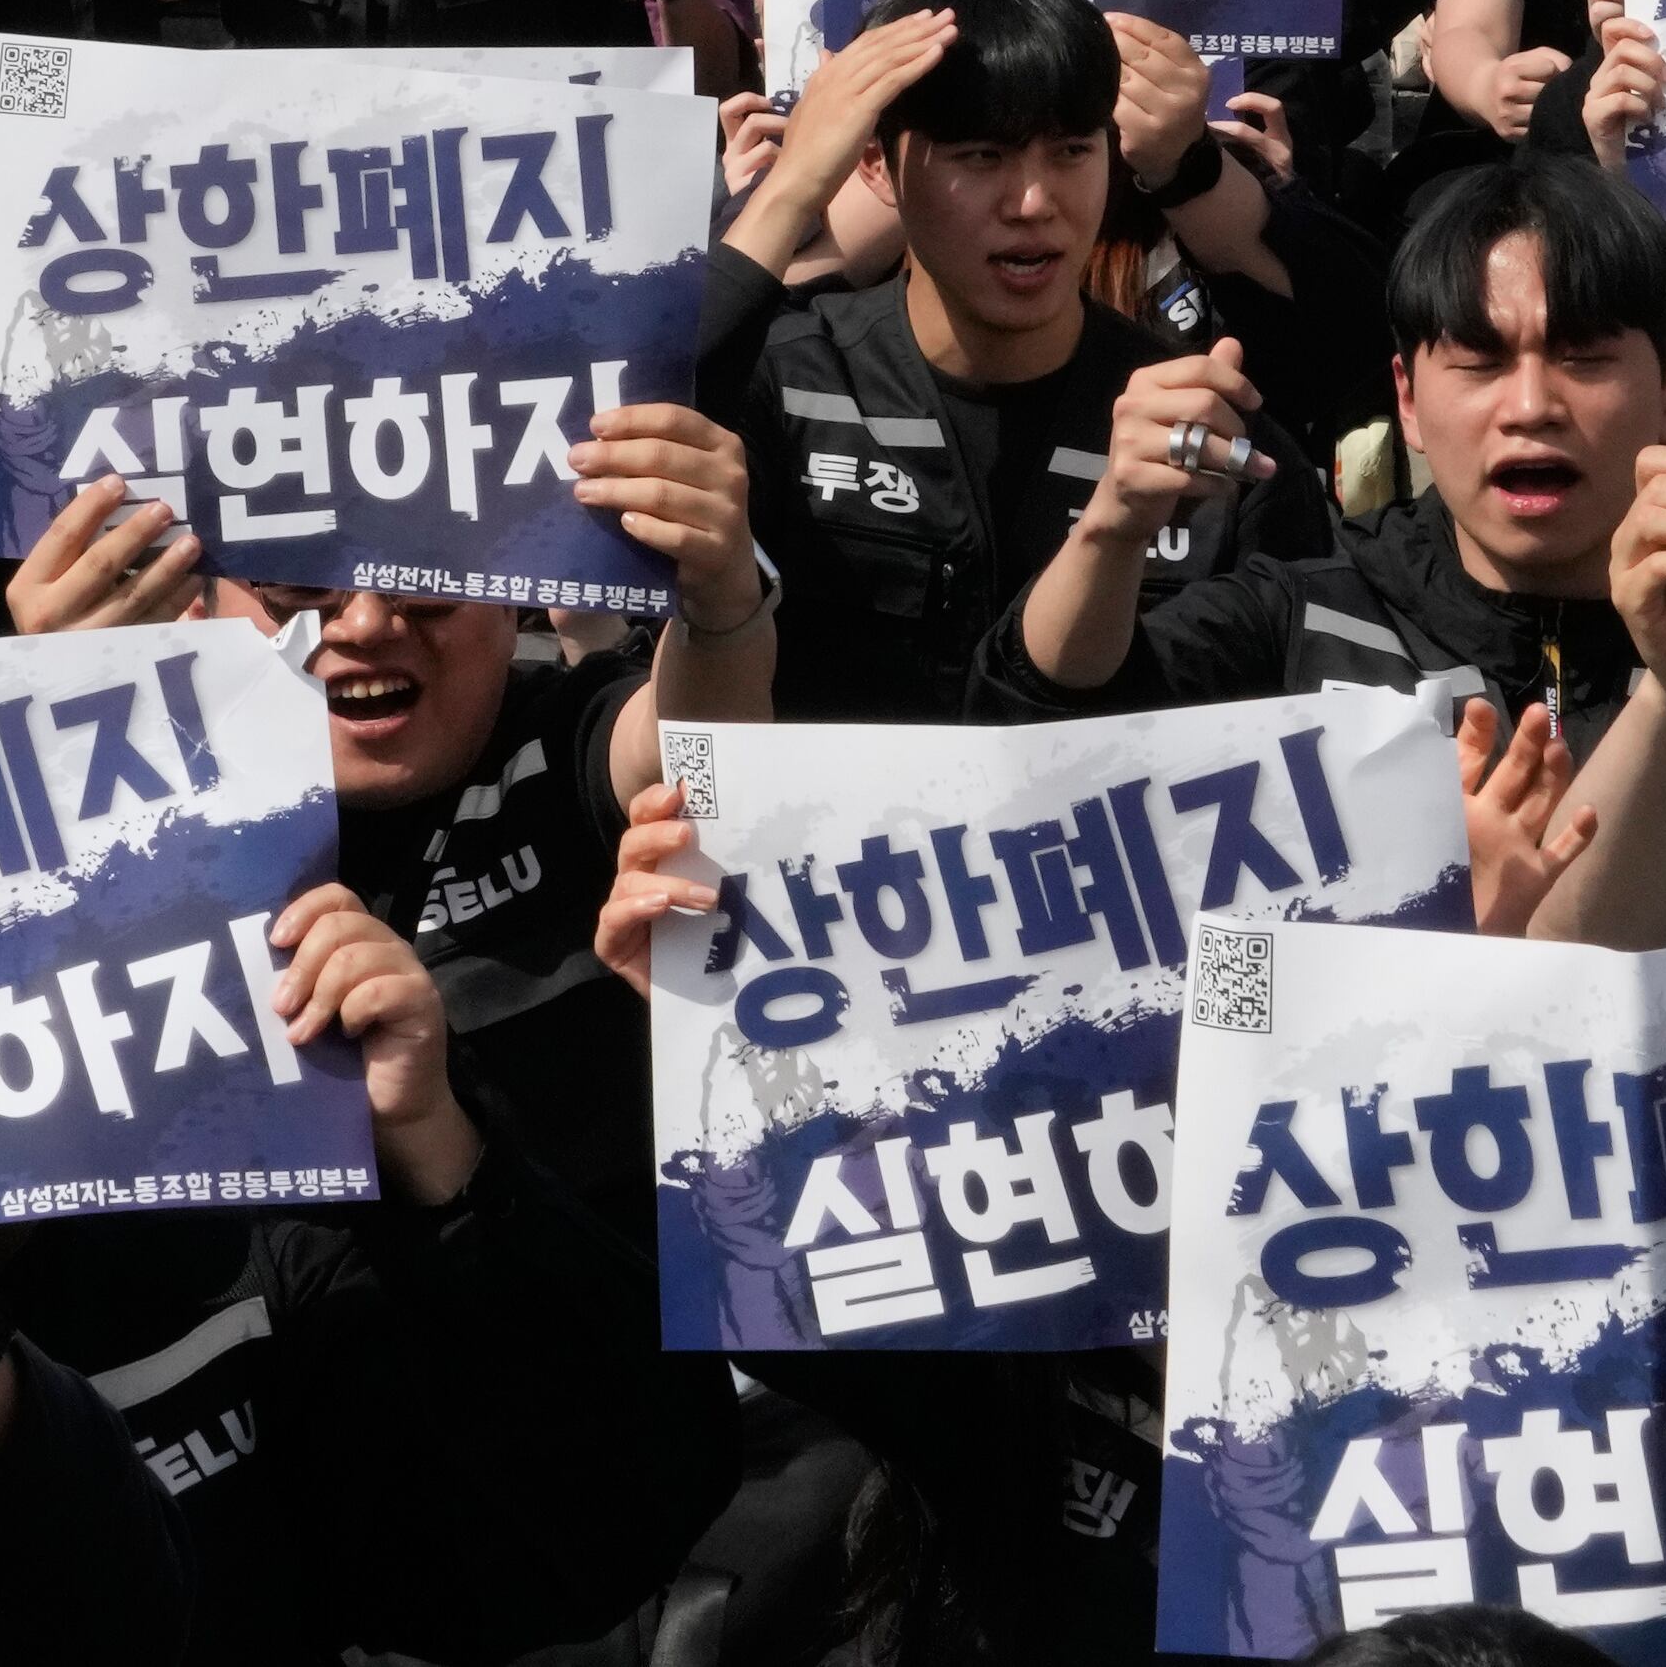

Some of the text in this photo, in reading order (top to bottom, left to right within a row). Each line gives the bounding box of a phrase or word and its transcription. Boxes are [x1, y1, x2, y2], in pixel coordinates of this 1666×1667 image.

[1241, 34, 1336, 56] 공동투쟁본부
[19, 114, 616, 314] 상한폐지
[802, 451, 919, 514] 투쟁
[352, 561, 670, 615] 삼성전자노동조합 공동투쟁본부
[416, 843, 544, 935] SELU
[705, 730, 1353, 1051] 상한폐지
[0, 1167, 369, 1218] 삼성전자노동조합 공동투쟁본부
[140, 1401, 257, 1497] ELU
